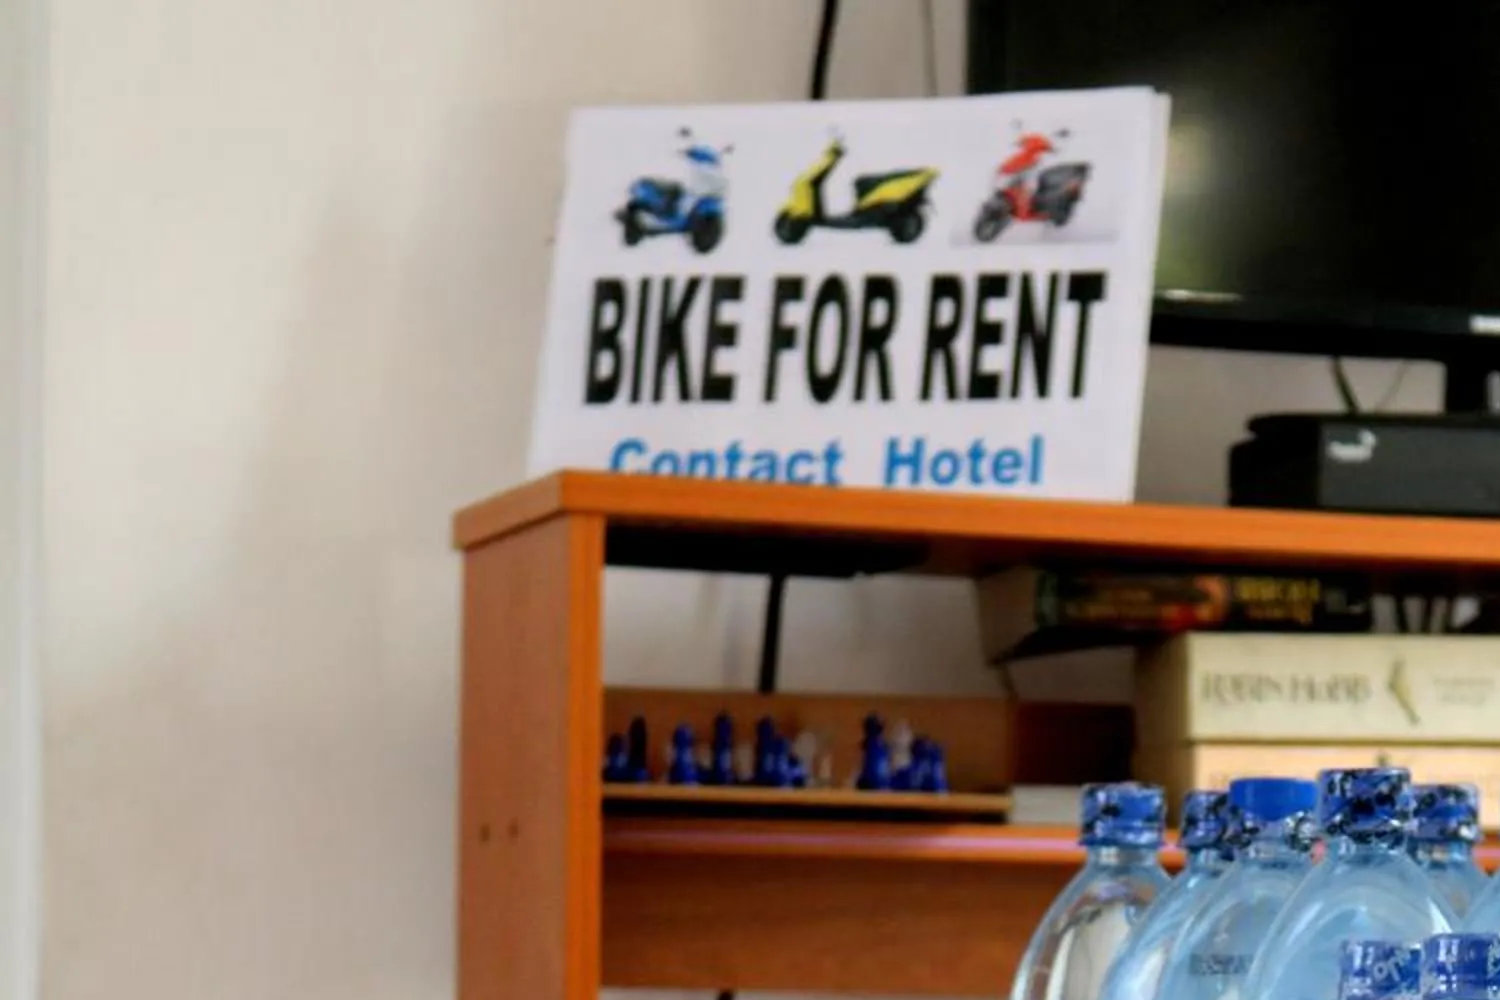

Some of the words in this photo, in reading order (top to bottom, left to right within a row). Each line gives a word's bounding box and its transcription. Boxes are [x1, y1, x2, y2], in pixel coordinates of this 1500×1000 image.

[582, 273, 747, 404] BIKE
[762, 272, 898, 403] FOR
[921, 270, 1108, 401] RENT
[609, 437, 845, 487] Contact
[883, 434, 1045, 487] Hotel
